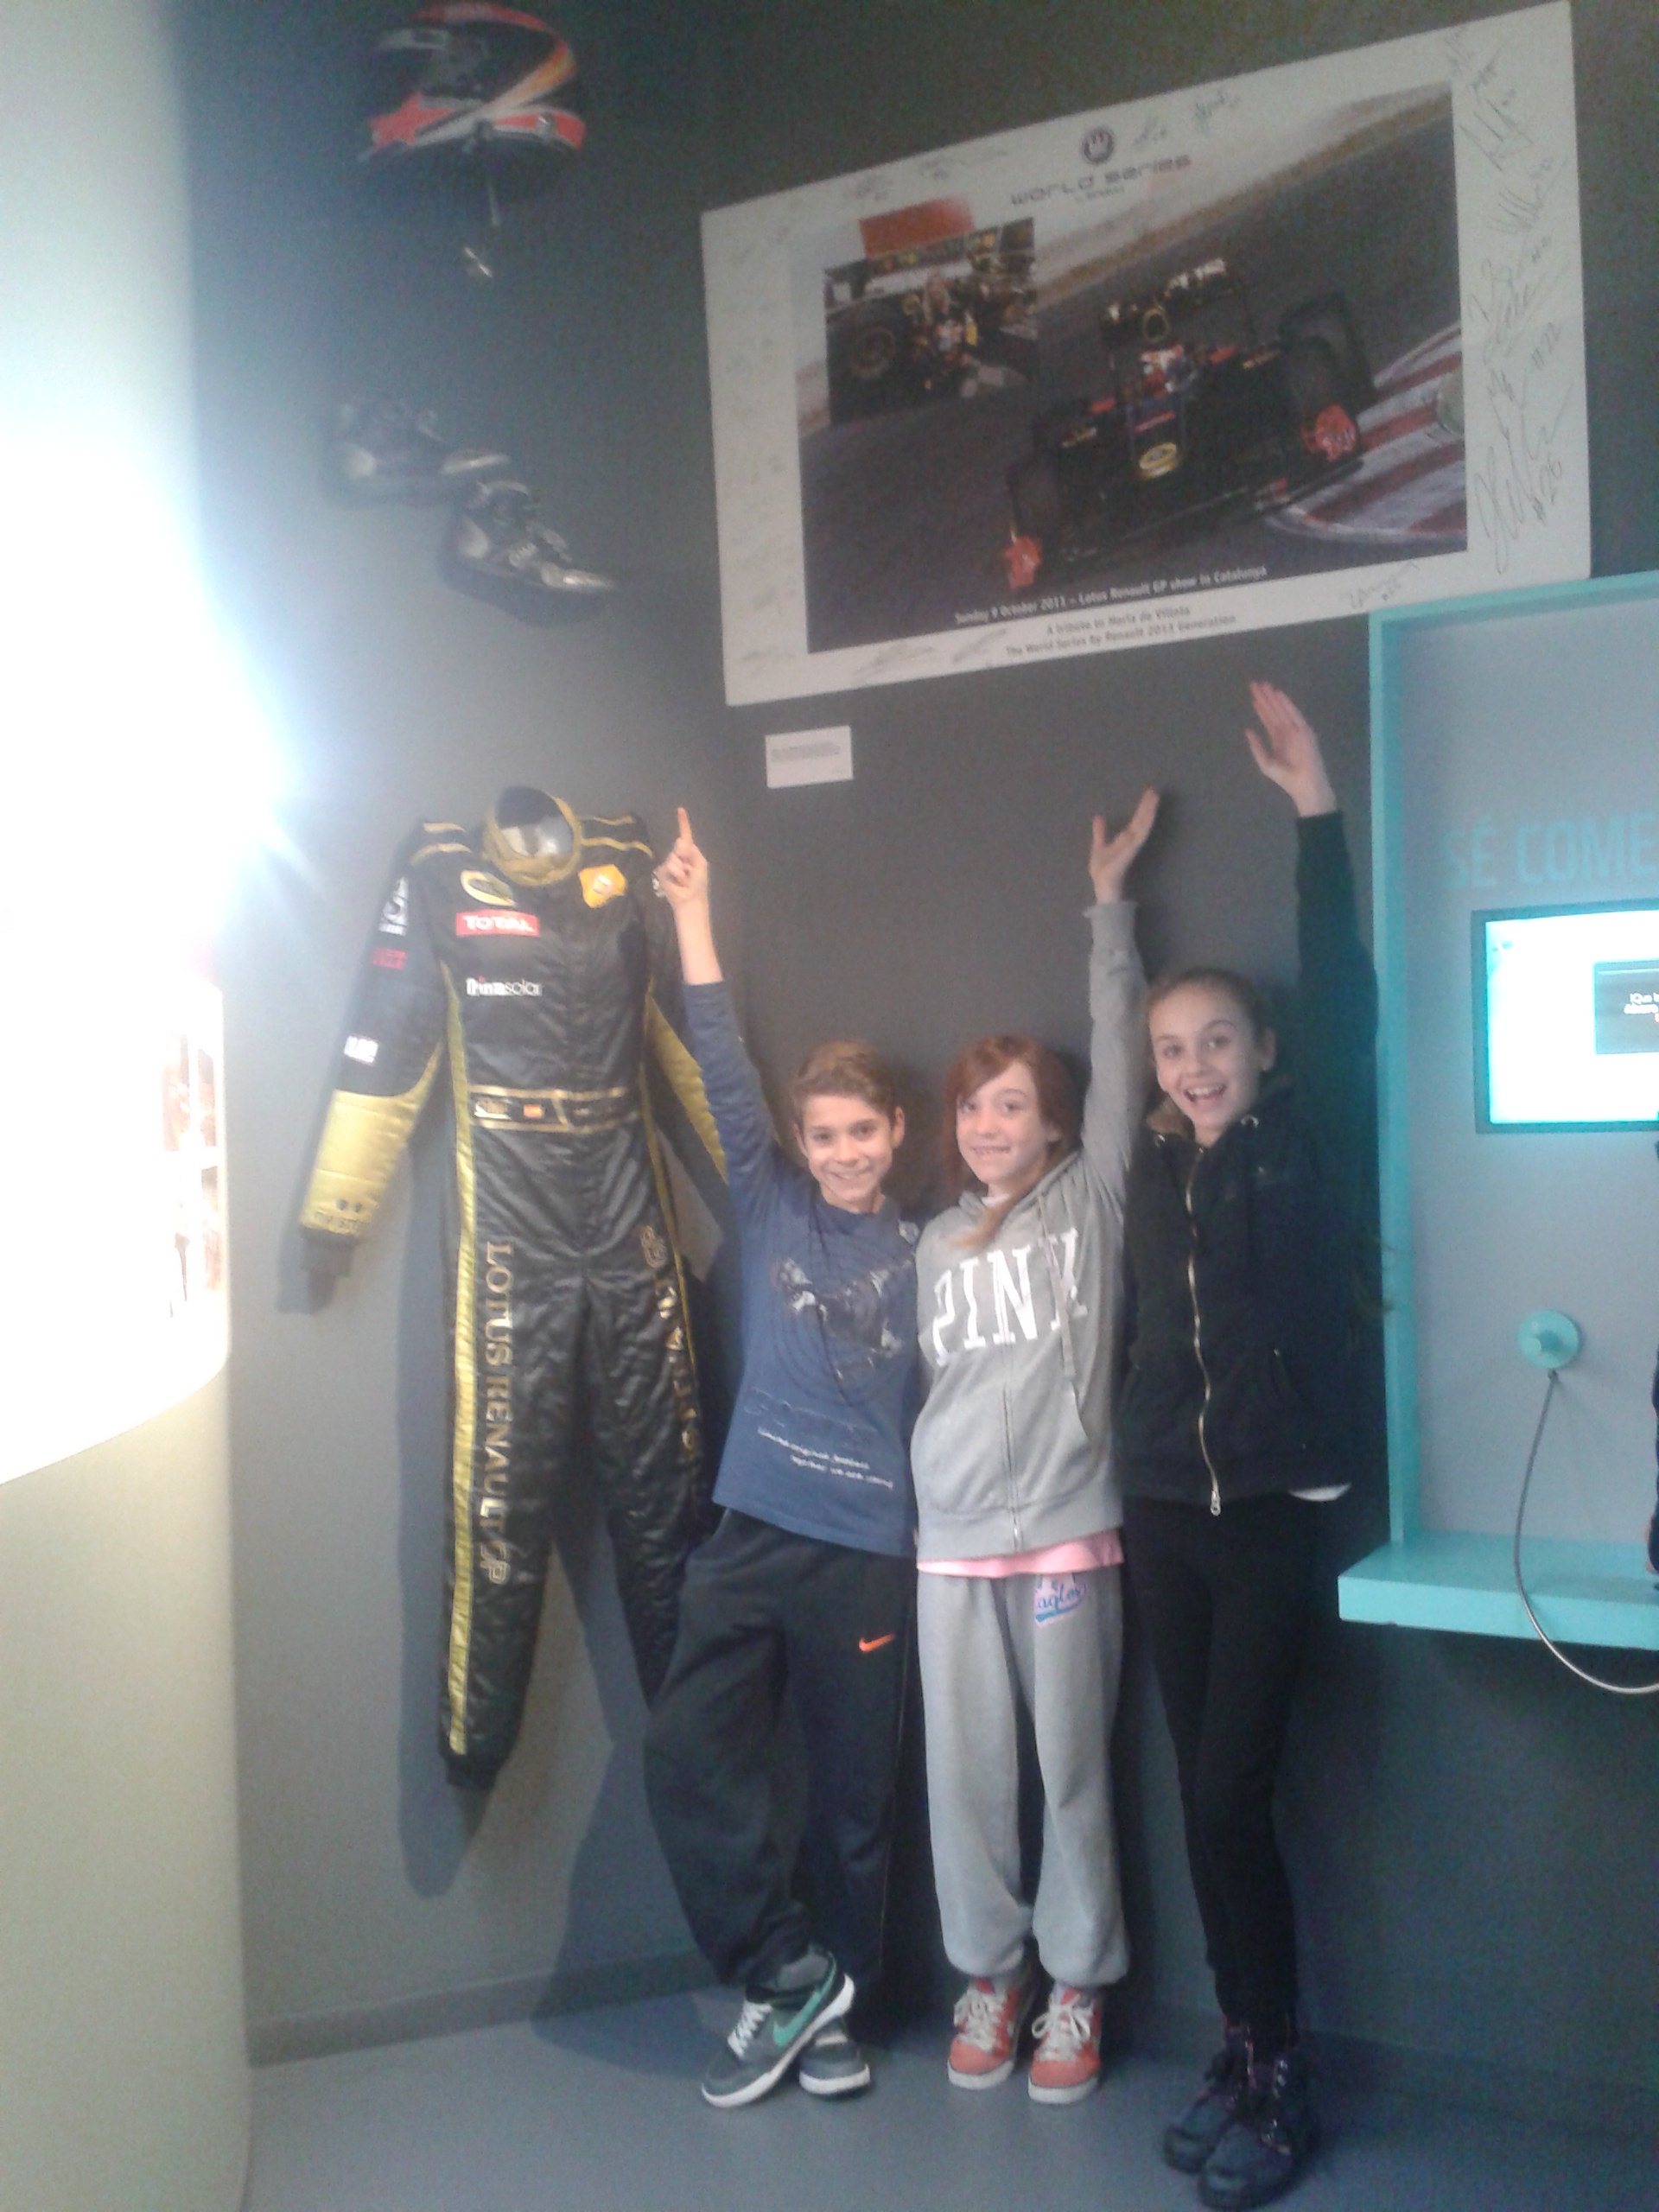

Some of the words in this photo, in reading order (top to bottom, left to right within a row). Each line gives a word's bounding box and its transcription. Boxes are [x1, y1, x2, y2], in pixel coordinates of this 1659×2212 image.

[1444, 816, 1497, 888] SÉ
[462, 915, 536, 933] TOTAL
[485, 1242, 514, 1367] LOTUS
[480, 1376, 513, 1533] RENAULT
